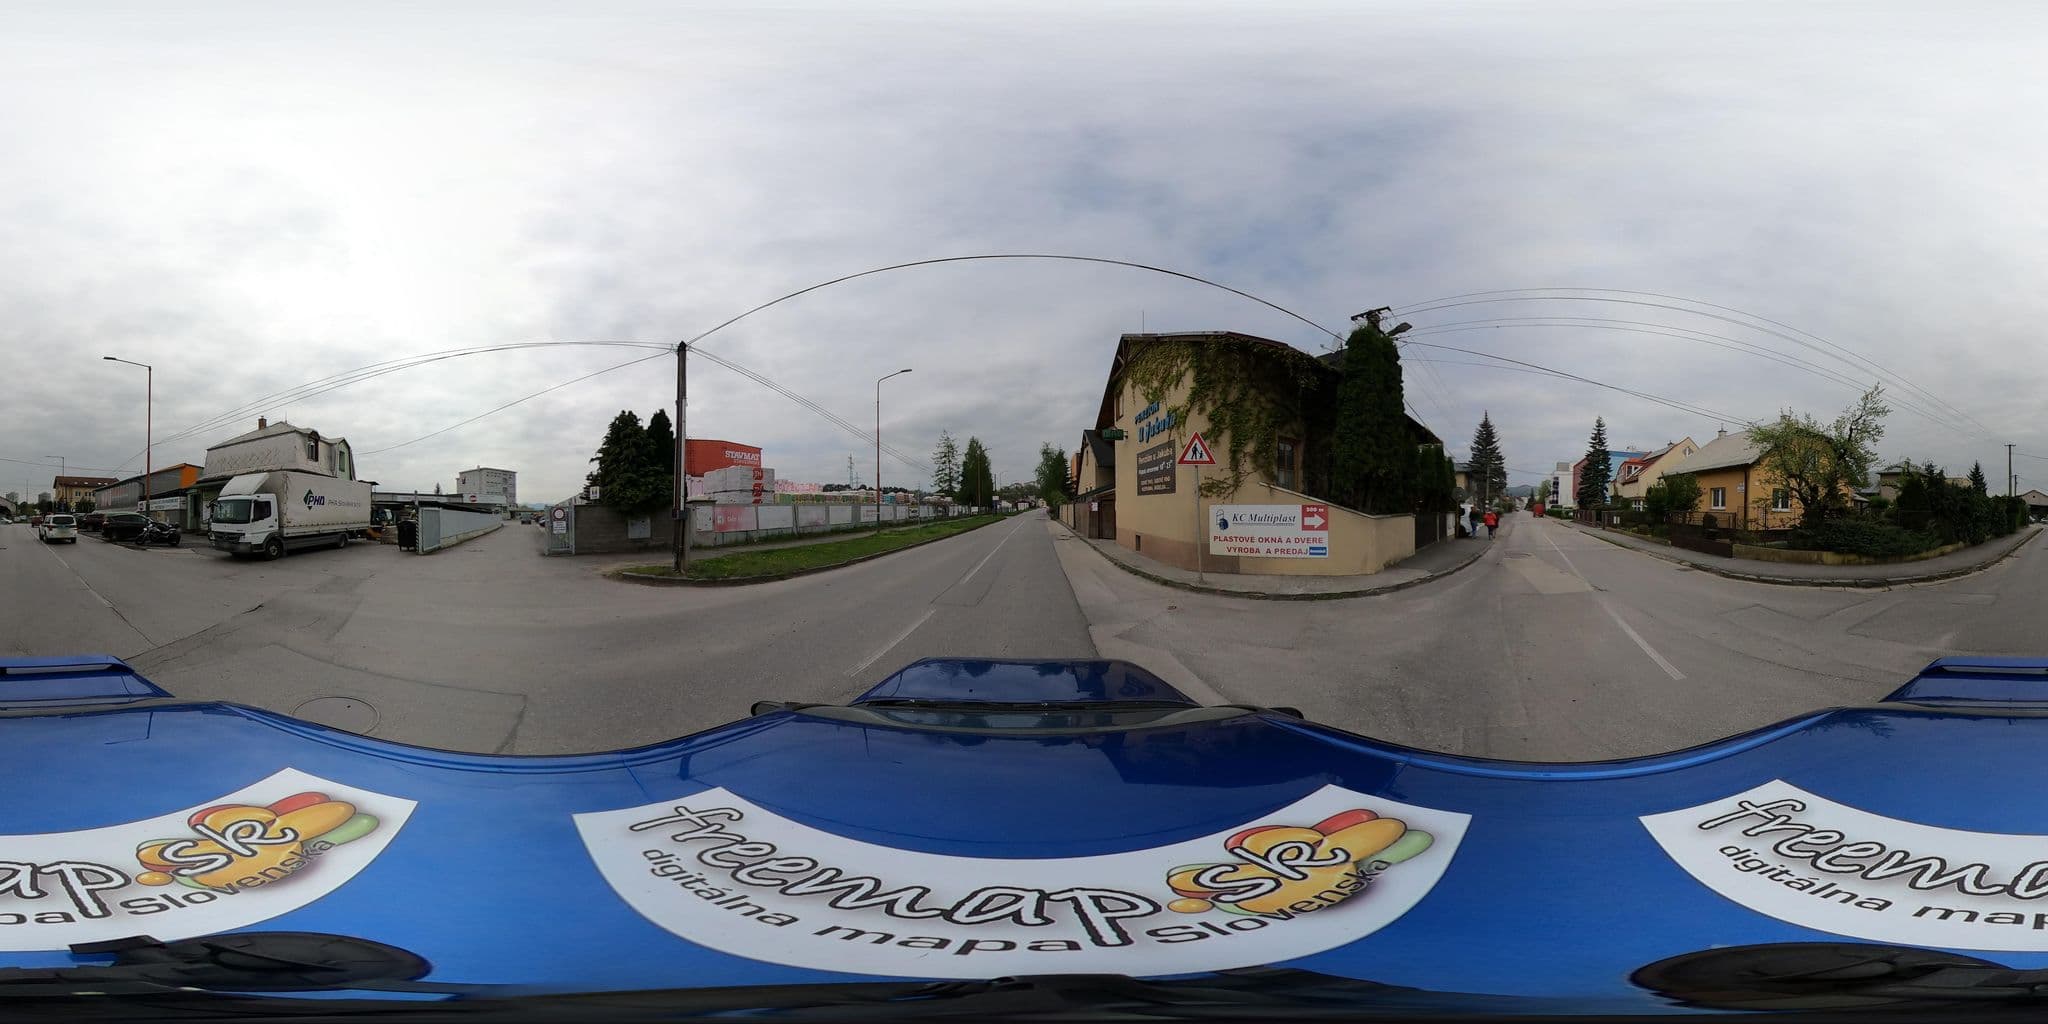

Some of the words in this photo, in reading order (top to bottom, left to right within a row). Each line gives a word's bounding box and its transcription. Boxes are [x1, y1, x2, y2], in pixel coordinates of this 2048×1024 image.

[725, 450, 760, 461] STAVMAT
[1232, 513, 1247, 522] KC
[1249, 513, 1296, 524] Multiplast
[119, 840, 337, 916] Slovenska
[642, 849, 801, 927] digitálna
[811, 925, 1083, 956] mapa
[1145, 859, 1394, 944] Slovenska
[1718, 845, 1894, 912] digitálna
